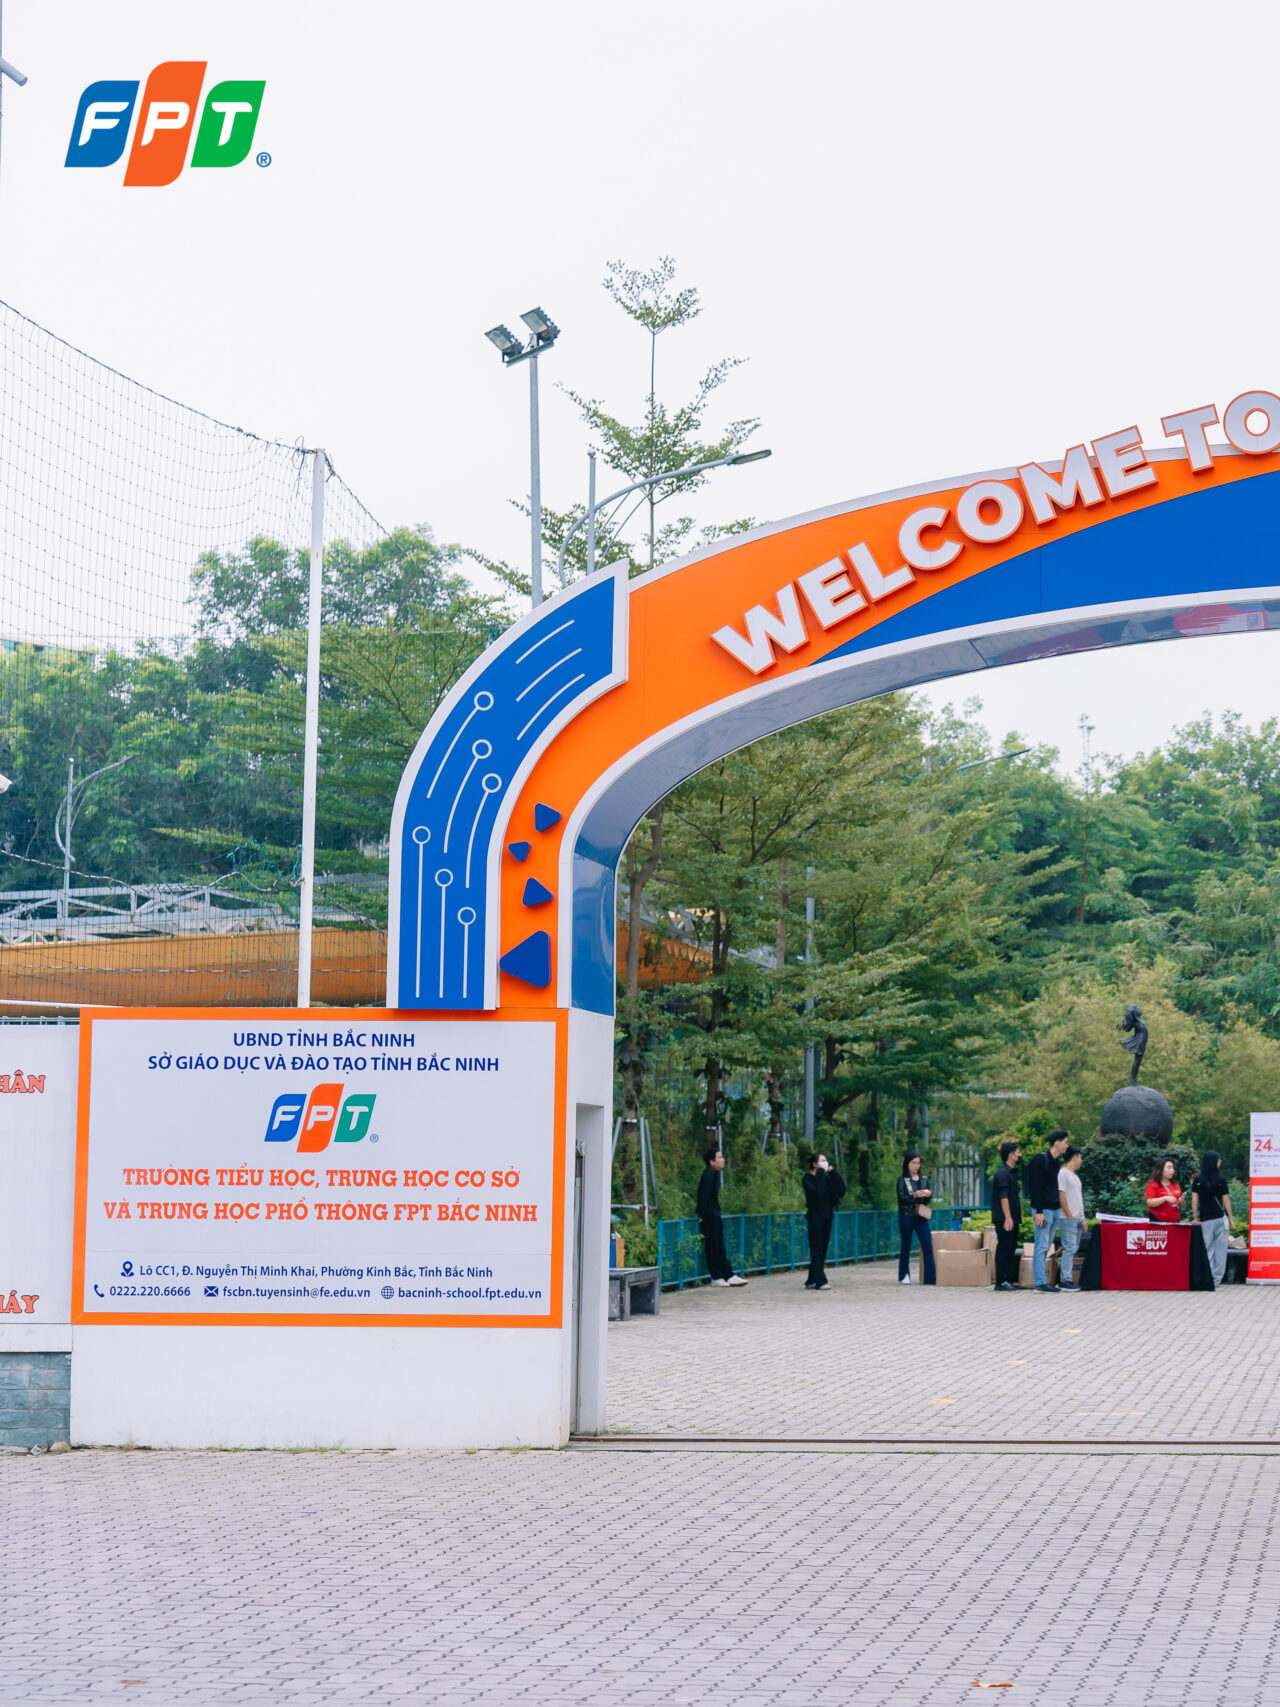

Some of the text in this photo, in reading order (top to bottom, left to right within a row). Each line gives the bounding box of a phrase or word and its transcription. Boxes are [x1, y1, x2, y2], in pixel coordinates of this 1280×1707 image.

[711, 425, 1158, 675] WELCOME
[233, 1028, 415, 1047] UBND TỈNH BẮC NINH
[148, 1051, 499, 1075] SỞ GIÁO DỤC VÀ ĐÀO TẠO TỈNH BẮC NINH
[1254, 1139, 1272, 1152] 24
[123, 1162, 520, 1191] TRƯỜNG TIỂU HỌC, TRUNG HỌC CƠ SỞ
[103, 1197, 538, 1223] VÀ TRUNG HỌC PHỔ THÔNG FPT BẮC NINH
[1146, 1241, 1168, 1250] BUV
[139, 1263, 493, 1279] Lô CC1, Đ. Nguyễn Thị Minh Khai, Phường Kinh Bắc, Tỉnh Bắc Ninh
[109, 1286, 542, 1300] 0222.220.6666 fscbn.tuyensinh@fe.edu.vn bacninh-school.fpt.edu.vn
